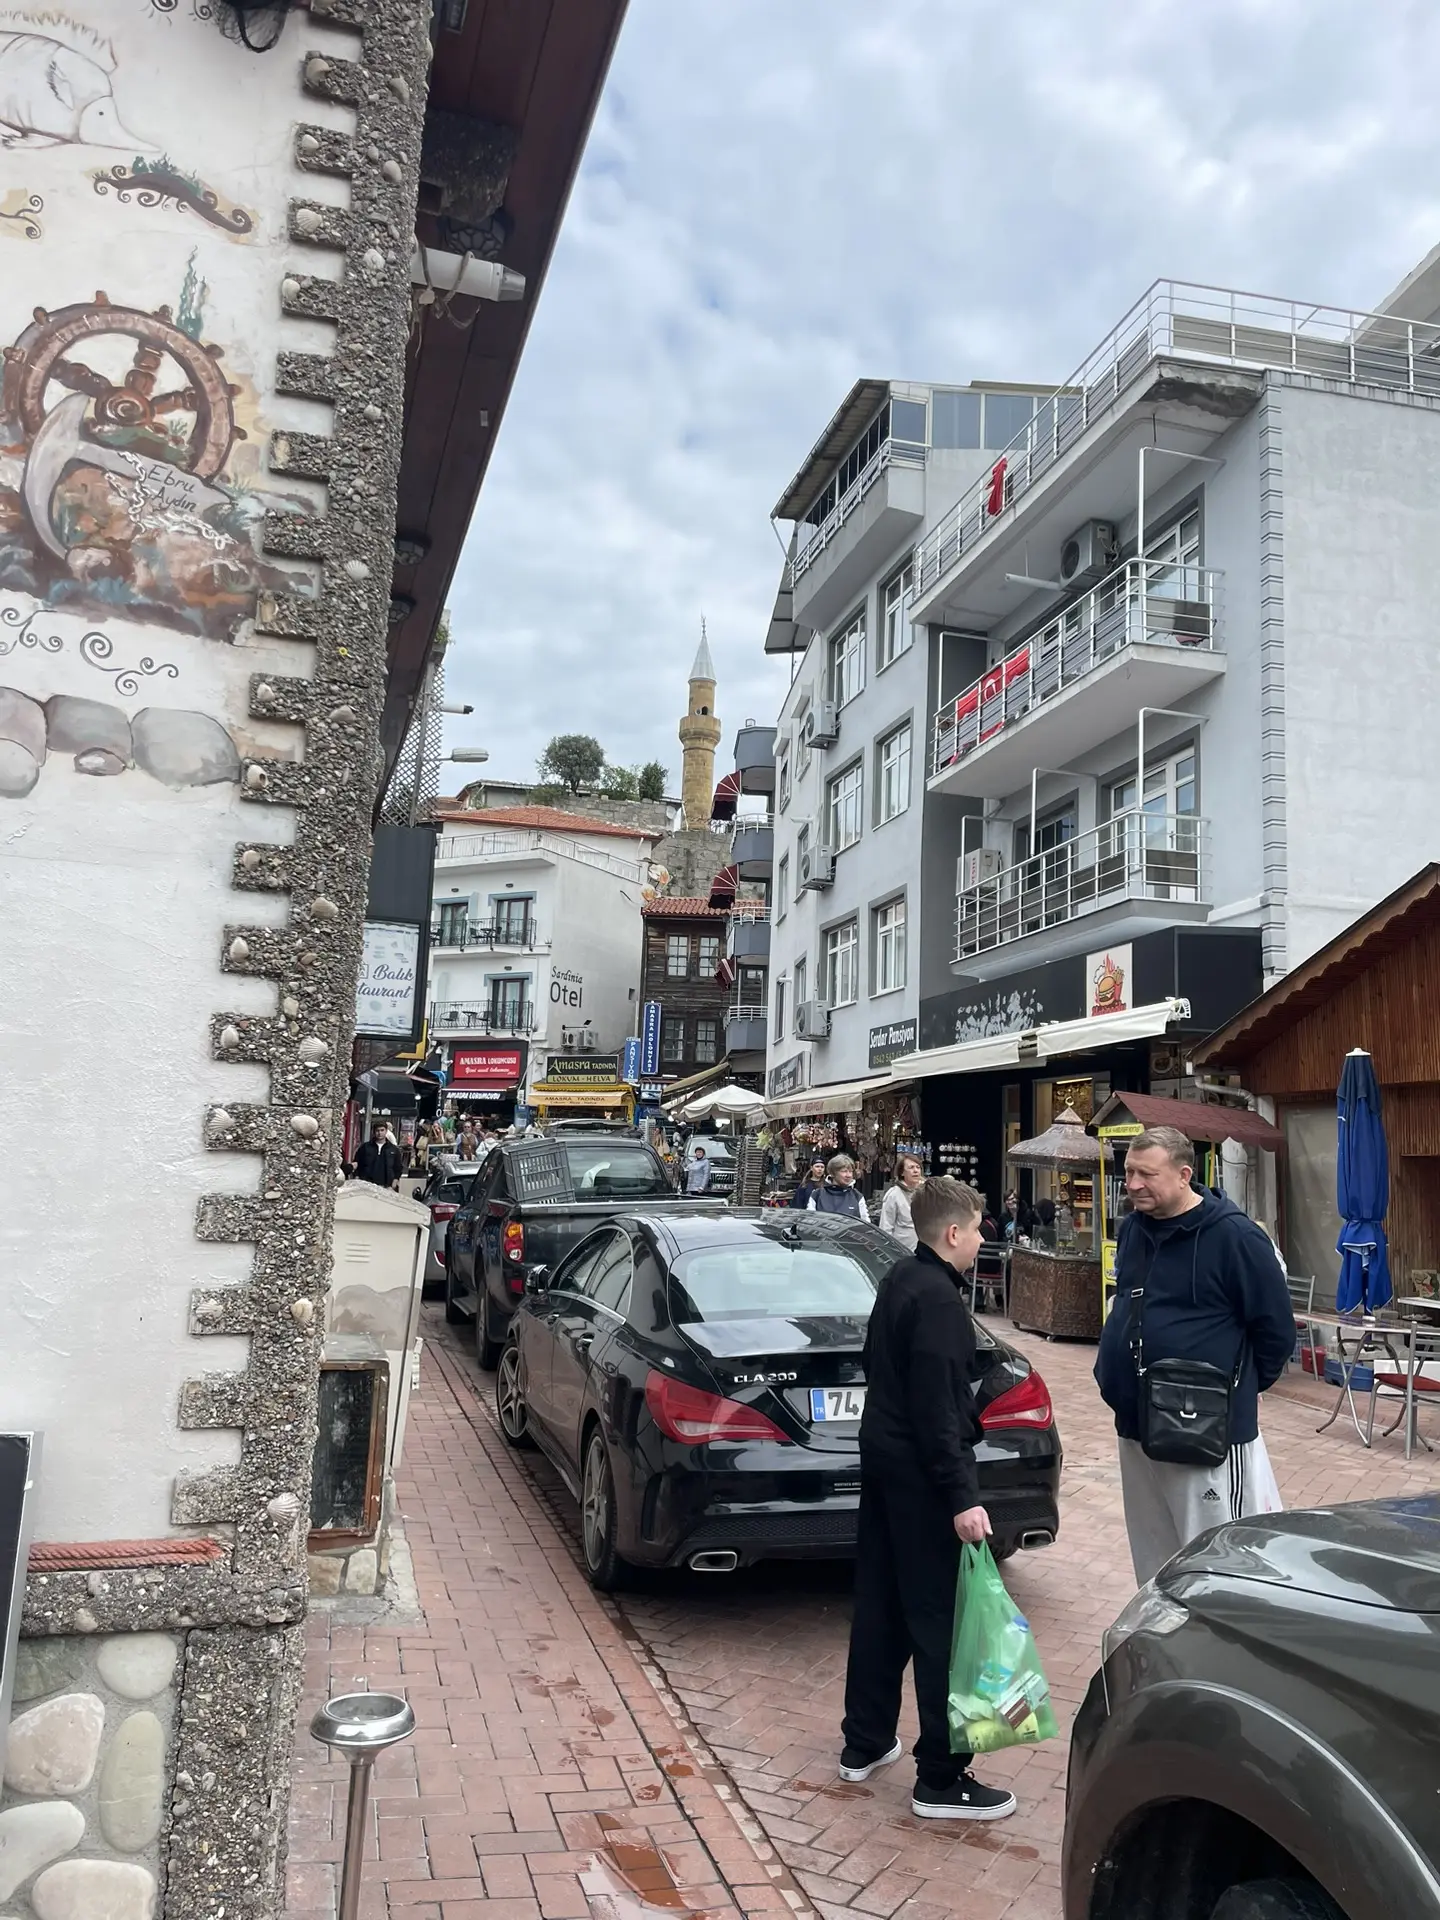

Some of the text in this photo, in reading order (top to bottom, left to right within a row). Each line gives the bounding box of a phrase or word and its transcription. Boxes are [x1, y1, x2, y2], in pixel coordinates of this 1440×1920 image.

[148, 464, 195, 493] Ebru
[551, 965, 583, 984] Sardinia
[357, 982, 413, 999] taurant
[550, 981, 583, 1008] Otel
[870, 1025, 915, 1048] Serdar Pansiyon
[548, 1058, 591, 1074] Amasra
[733, 1372, 798, 1383] CLA 200
[815, 1391, 860, 1417] TR 74
